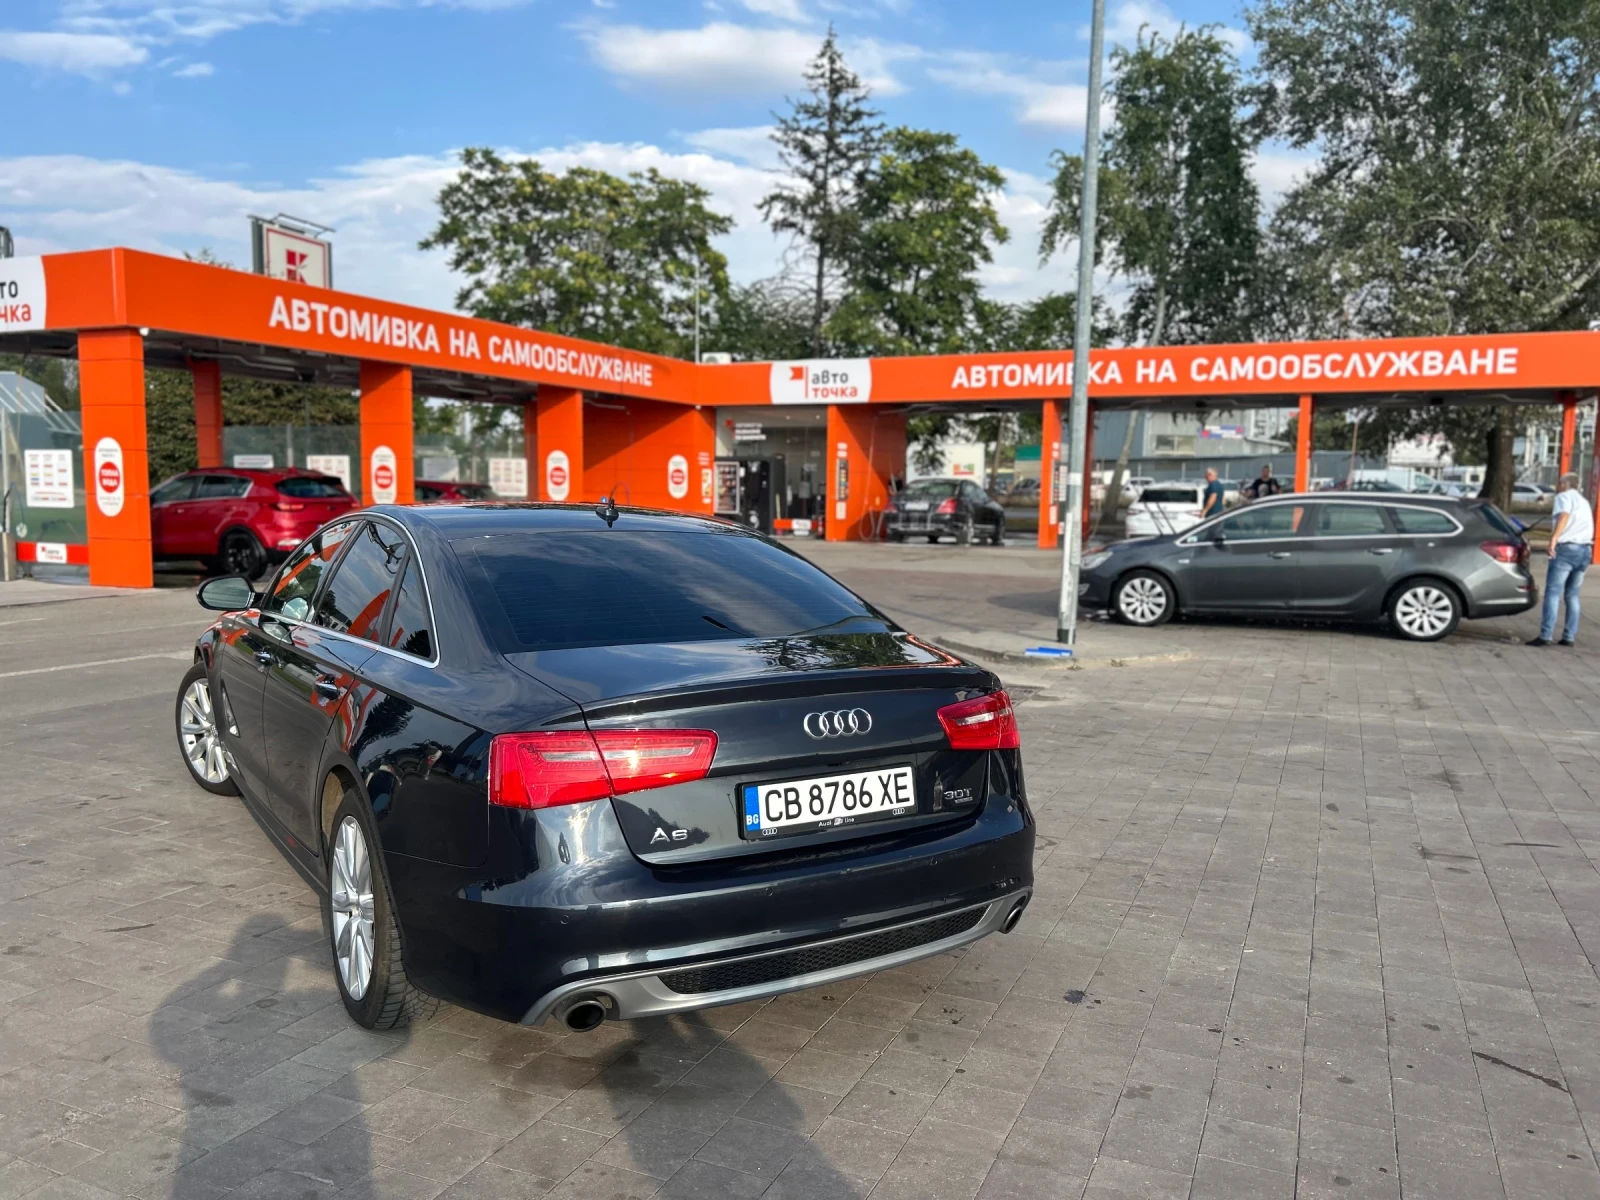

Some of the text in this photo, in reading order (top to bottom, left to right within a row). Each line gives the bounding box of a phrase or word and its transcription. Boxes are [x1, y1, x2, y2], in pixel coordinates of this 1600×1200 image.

[269, 295, 653, 387] АВТОМИВКА НА САМООБСЛУЖВАНЕ
[1136, 358, 1176, 383] НА
[1190, 347, 1518, 382] САМООБСЛУЖВАНЕ
[812, 370, 849, 384] авто
[812, 386, 858, 398] точка
[764, 772, 910, 822] CB 8786 XE
[746, 814, 759, 826] BG
[650, 827, 688, 844] A6
